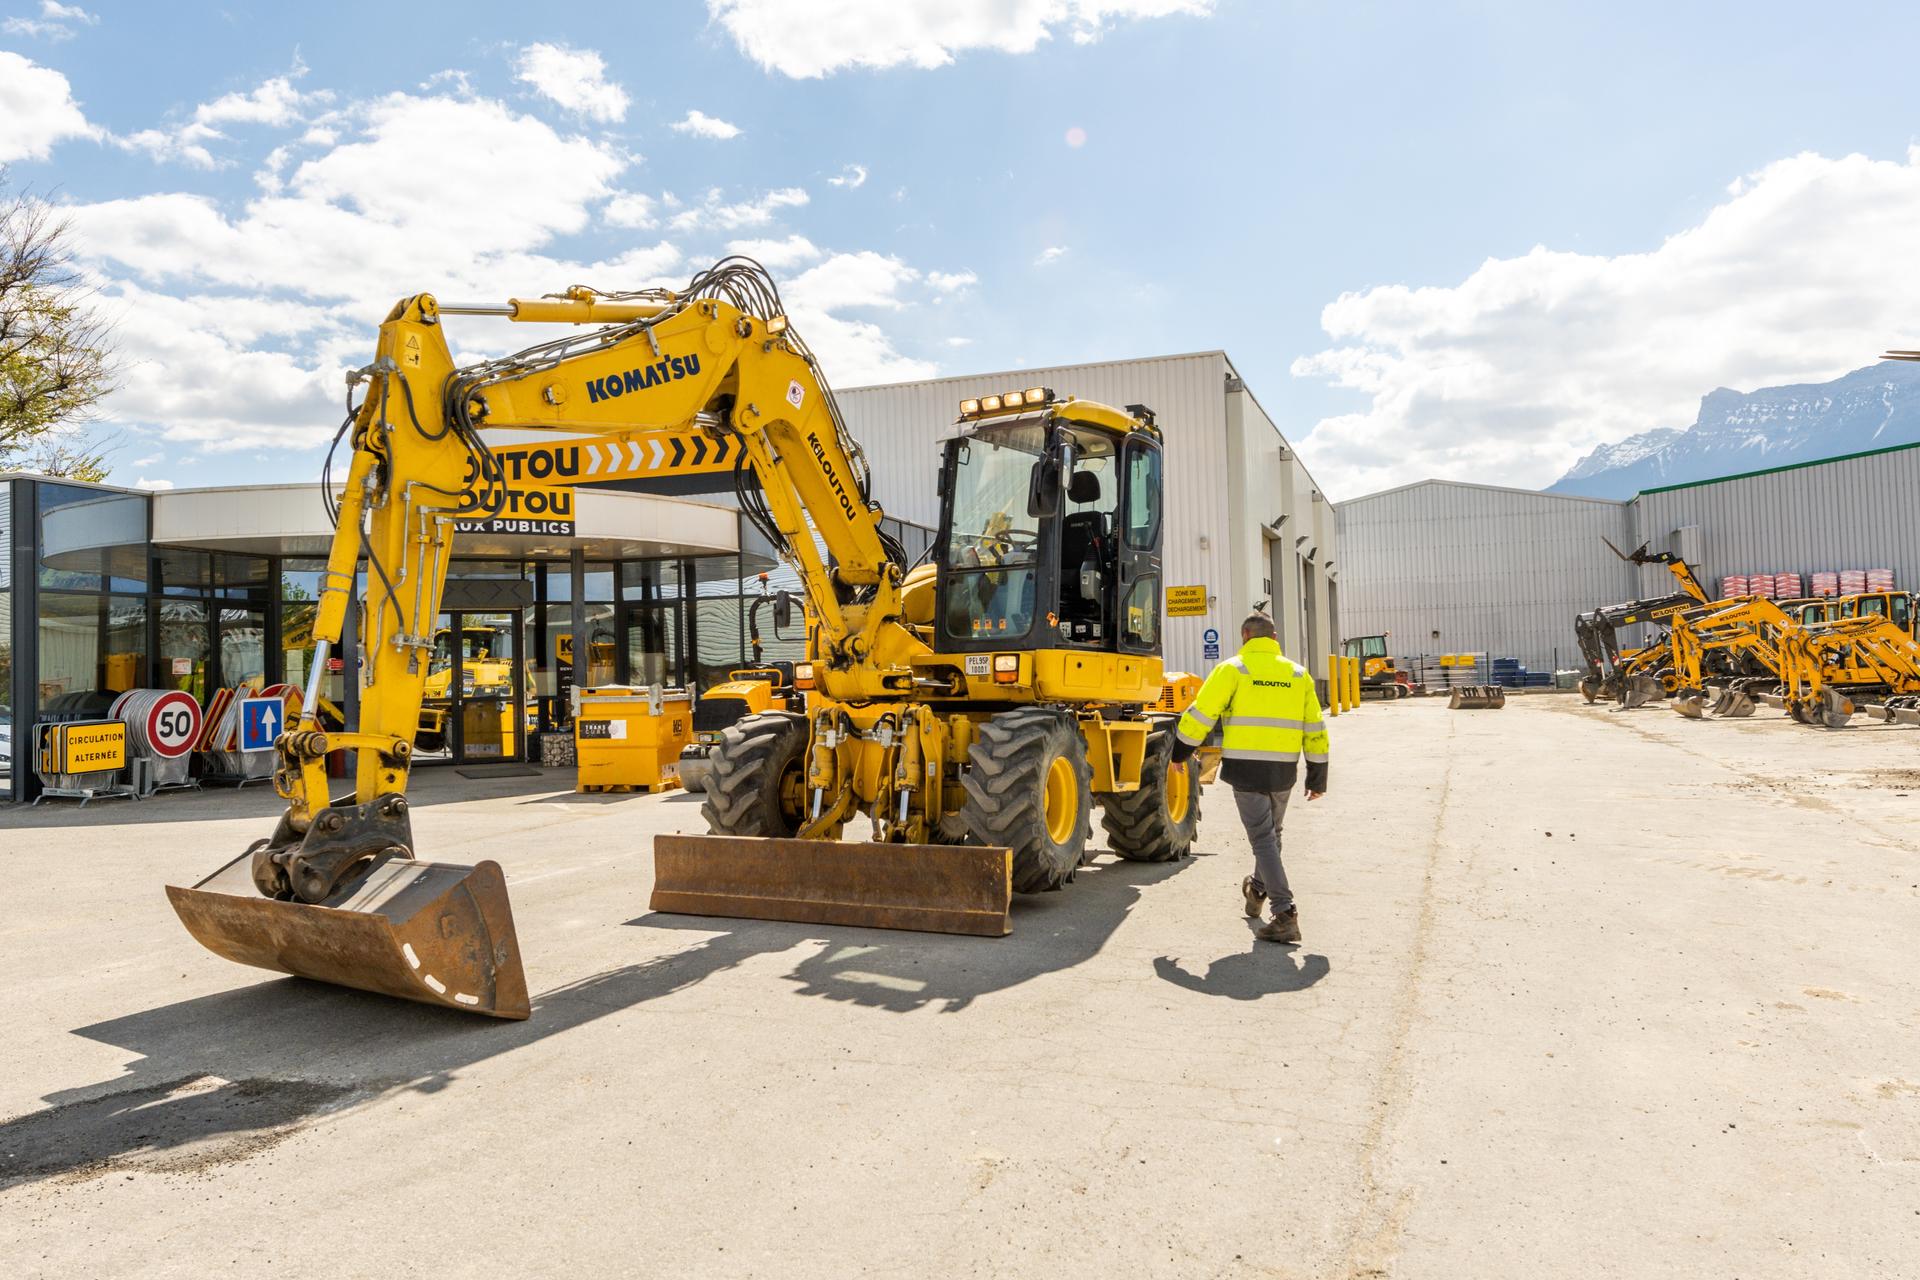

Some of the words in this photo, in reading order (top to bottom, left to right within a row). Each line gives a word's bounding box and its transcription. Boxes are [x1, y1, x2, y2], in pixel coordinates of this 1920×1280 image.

[586, 353, 701, 403] KOMATSU
[493, 520, 570, 534] PUBLICS
[159, 711, 191, 738] 50
[68, 733, 124, 745] CIRCULATION
[75, 751, 118, 762] ALTERNÉE
